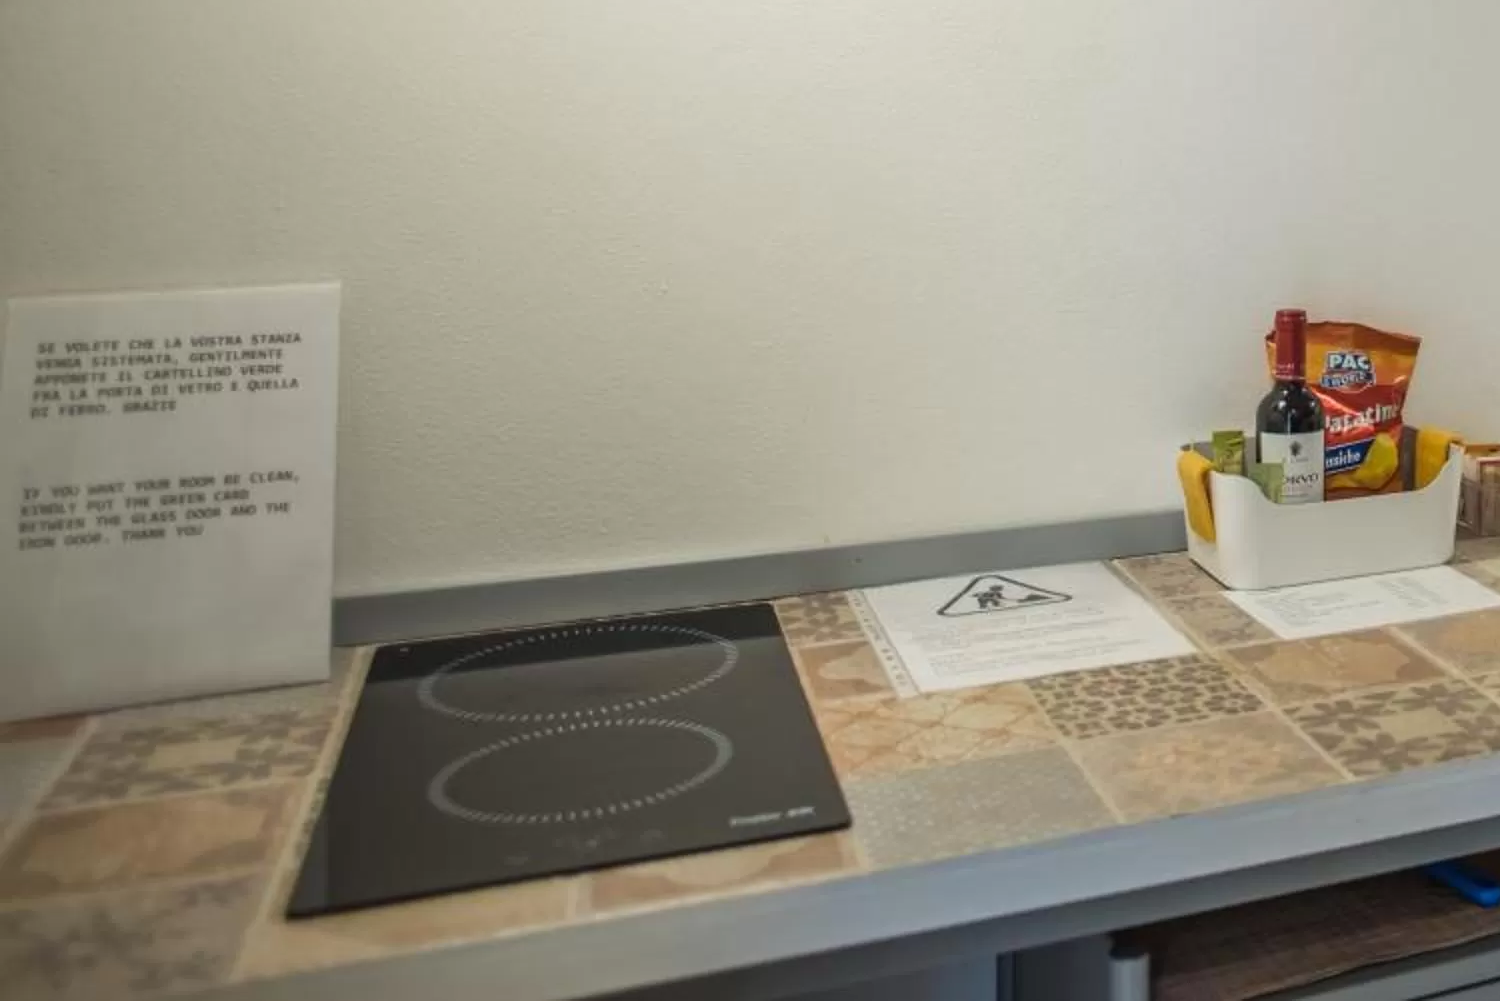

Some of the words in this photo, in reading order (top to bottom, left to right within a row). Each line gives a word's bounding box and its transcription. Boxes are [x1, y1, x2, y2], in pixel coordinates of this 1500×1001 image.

[66, 340, 119, 353] VOLETE
[129, 339, 152, 349] CHE
[191, 335, 242, 347] VOSTRA
[252, 333, 301, 344] STANZA
[190, 349, 282, 362] GENTILMENTE
[1328, 354, 1370, 370] PAC
[144, 367, 232, 381] CARTELLINO
[240, 364, 283, 376] VERDE
[98, 386, 142, 398] PORTA
[179, 382, 222, 394] VETRO
[247, 378, 299, 392] QUELLA
